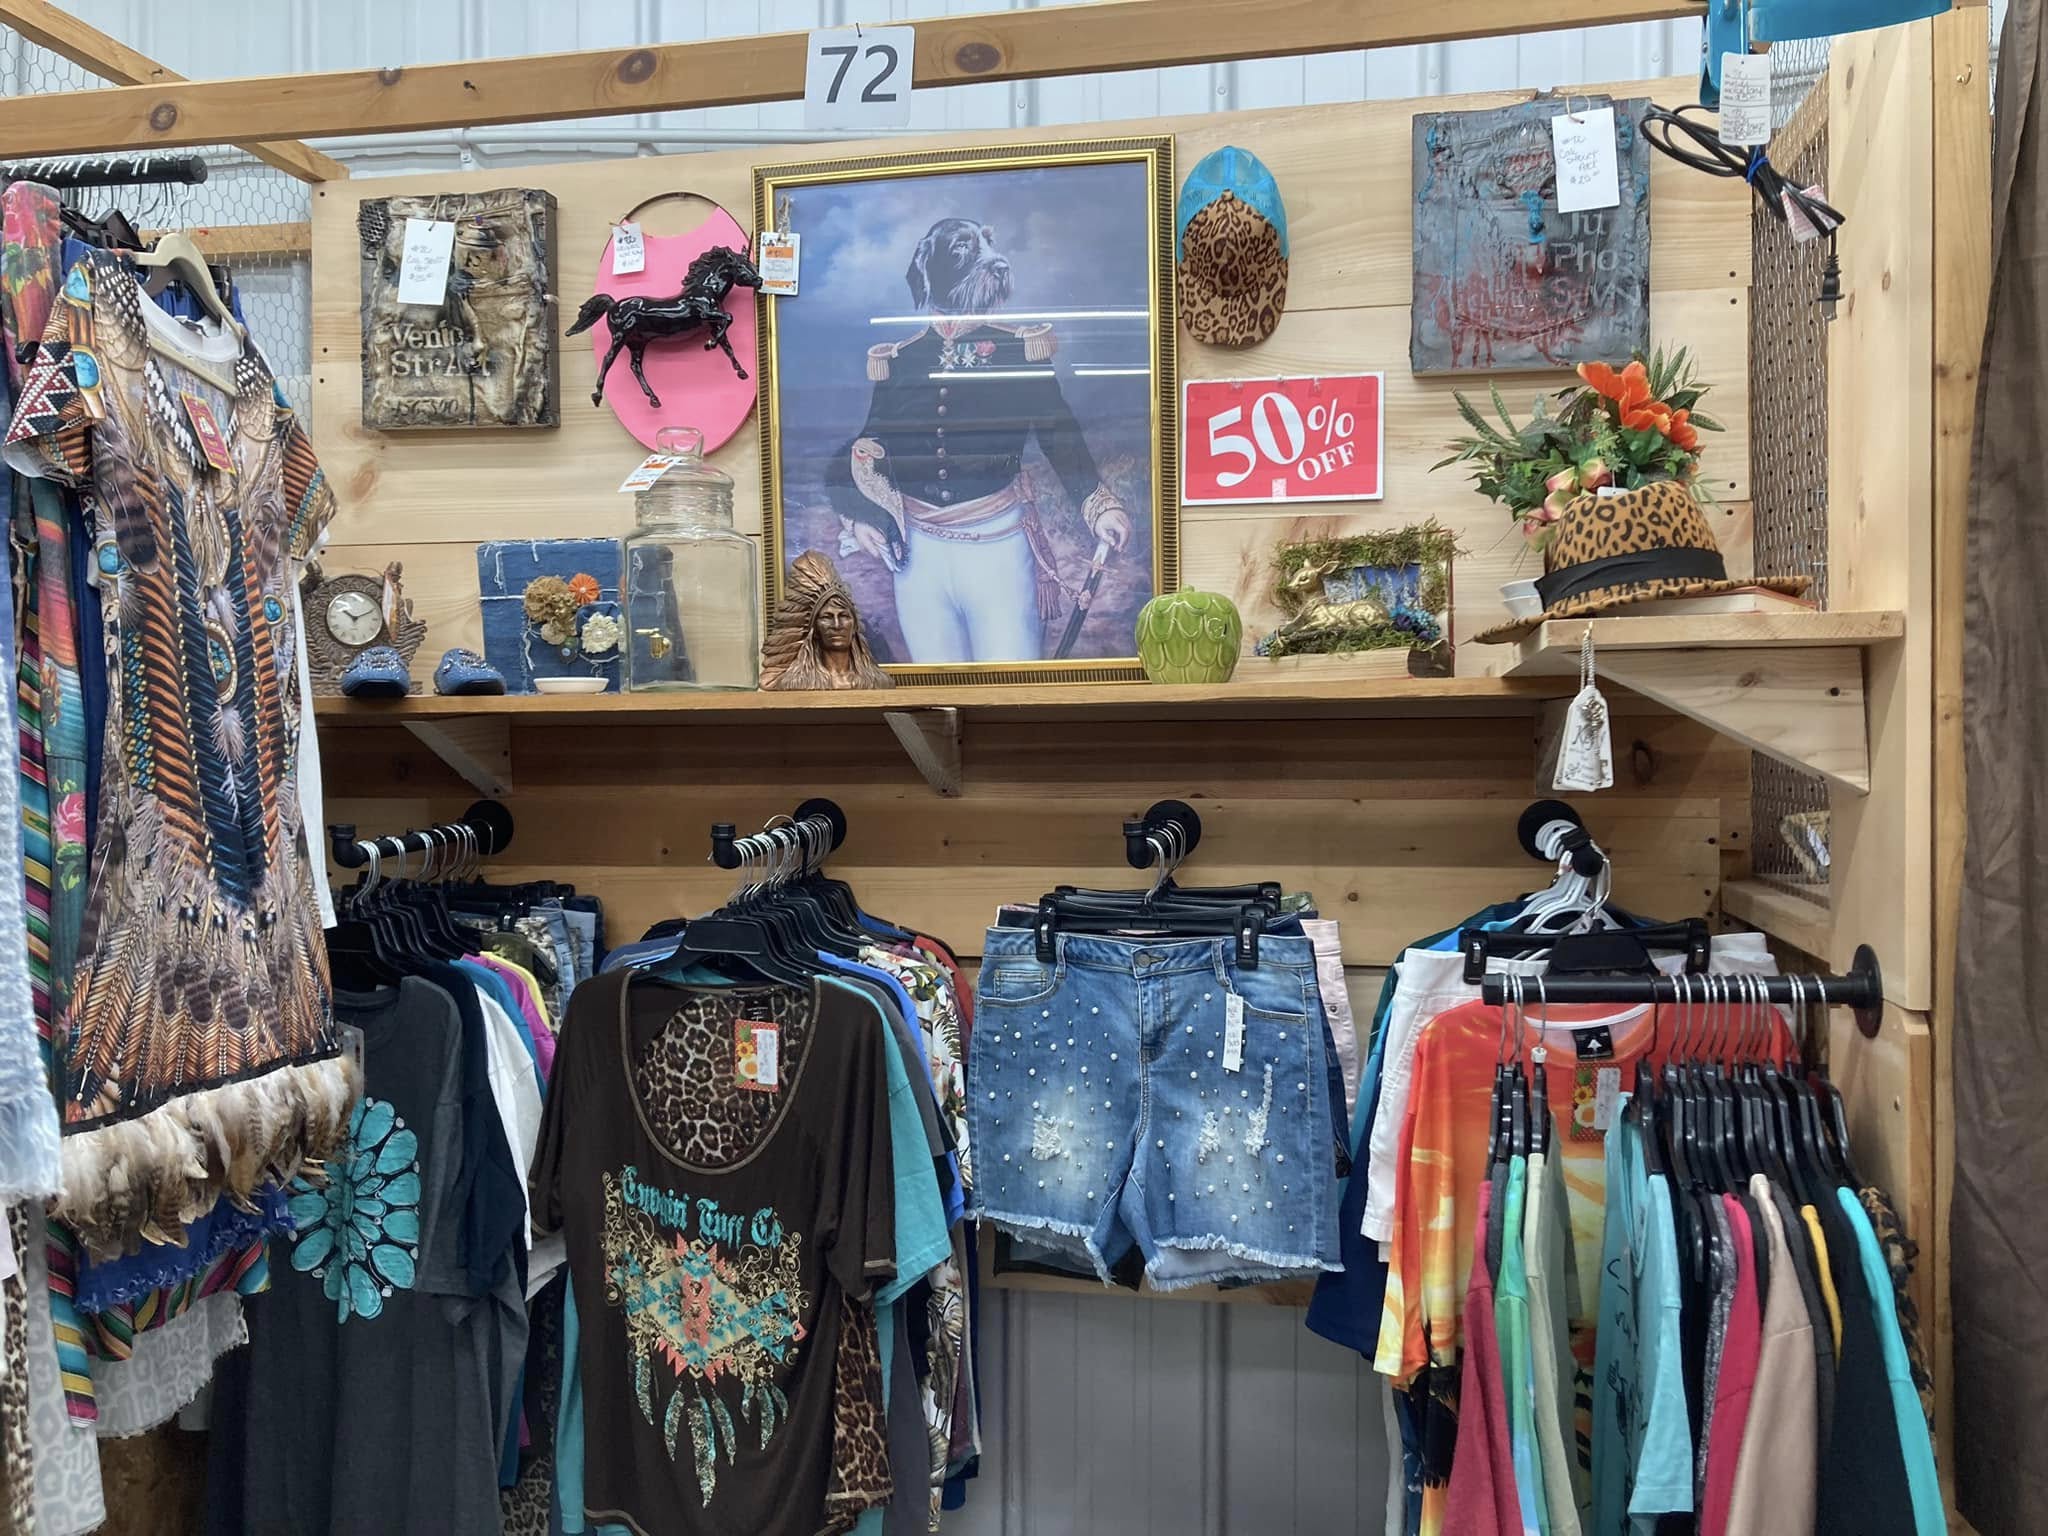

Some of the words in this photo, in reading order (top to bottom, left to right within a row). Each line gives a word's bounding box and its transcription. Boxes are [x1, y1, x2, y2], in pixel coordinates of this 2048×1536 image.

[821, 44, 898, 104] 72
[1208, 391, 1355, 488] 50%
[1297, 441, 1356, 481] OFF
[696, 1197, 745, 1250] Tuff
